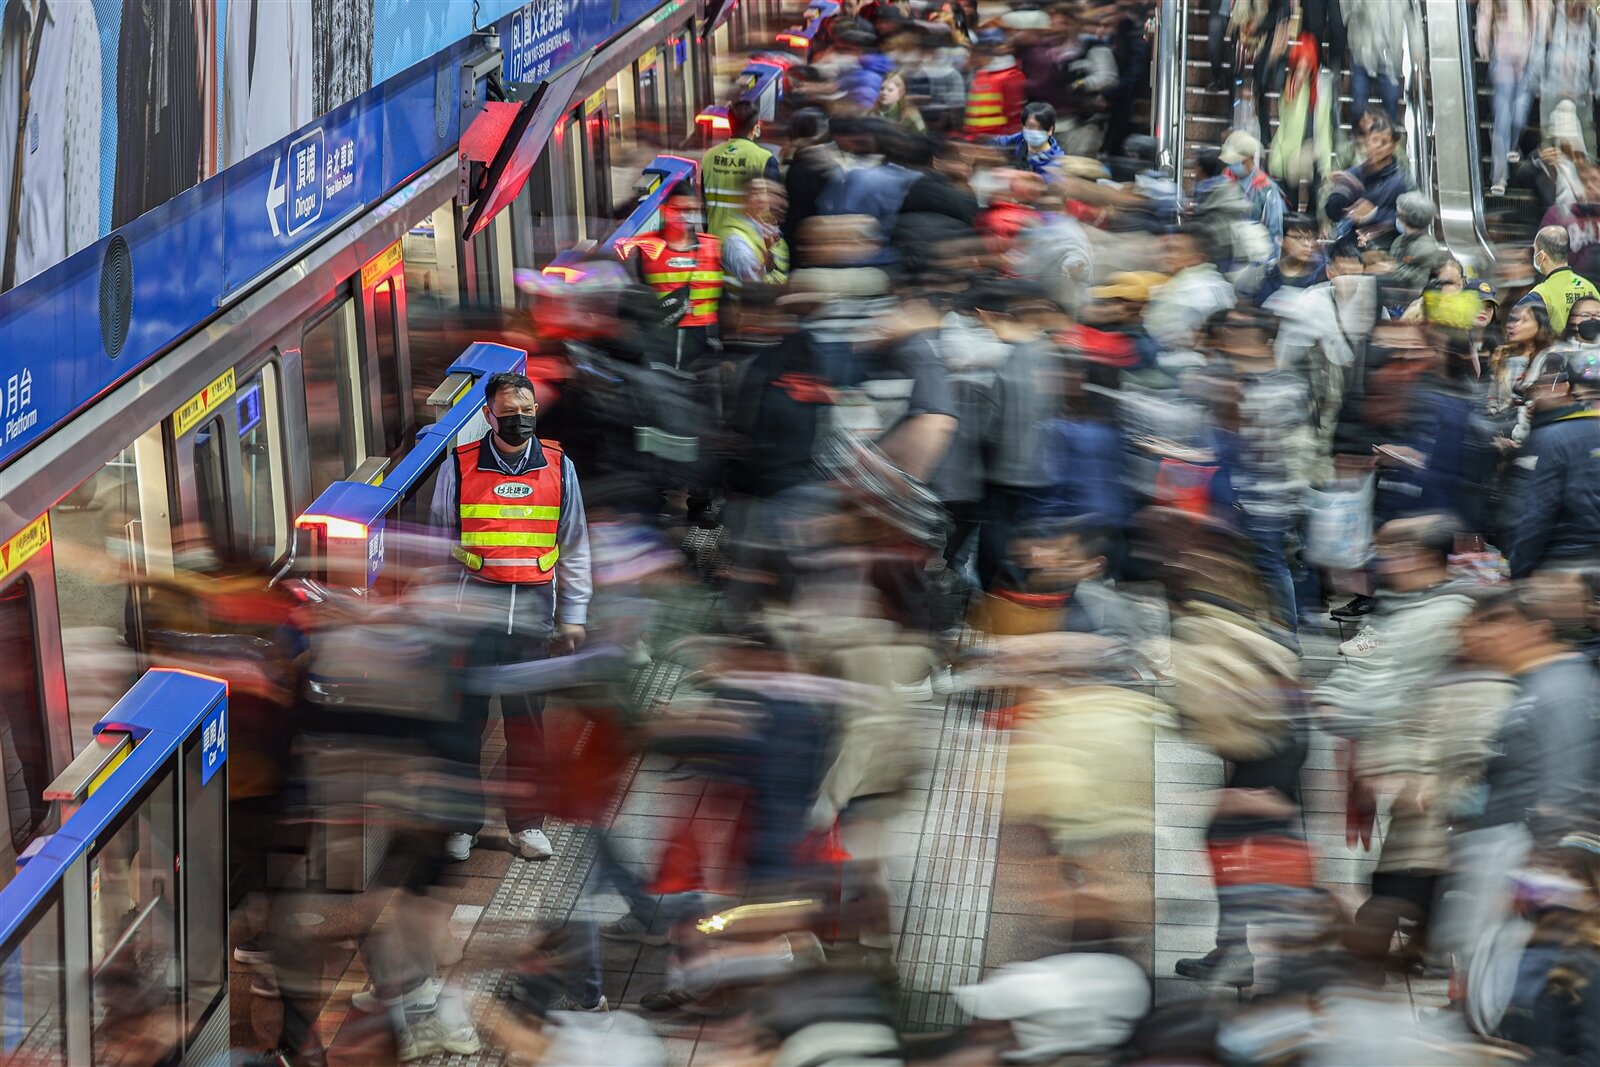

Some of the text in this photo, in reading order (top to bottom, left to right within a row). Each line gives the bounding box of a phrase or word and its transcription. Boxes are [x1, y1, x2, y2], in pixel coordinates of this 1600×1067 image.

[514, 24, 521, 50] BL
[524, 0, 563, 47] 國父紀念館
[524, 28, 570, 68] SUN YAT-SEN MEMORIAL HALL
[514, 53, 520, 79] 17
[296, 143, 316, 192] 頂埔
[326, 140, 354, 181] 台北車站
[326, 184, 334, 200] Taipei
[342, 172, 353, 188] Station
[295, 193, 316, 219] Dingpu
[6, 367, 32, 419] 月台
[6, 409, 38, 443] Platform
[379, 528, 384, 562] 4
[203, 719, 216, 753] 車廂
[217, 710, 225, 753] 4
[209, 749, 217, 767] Car
